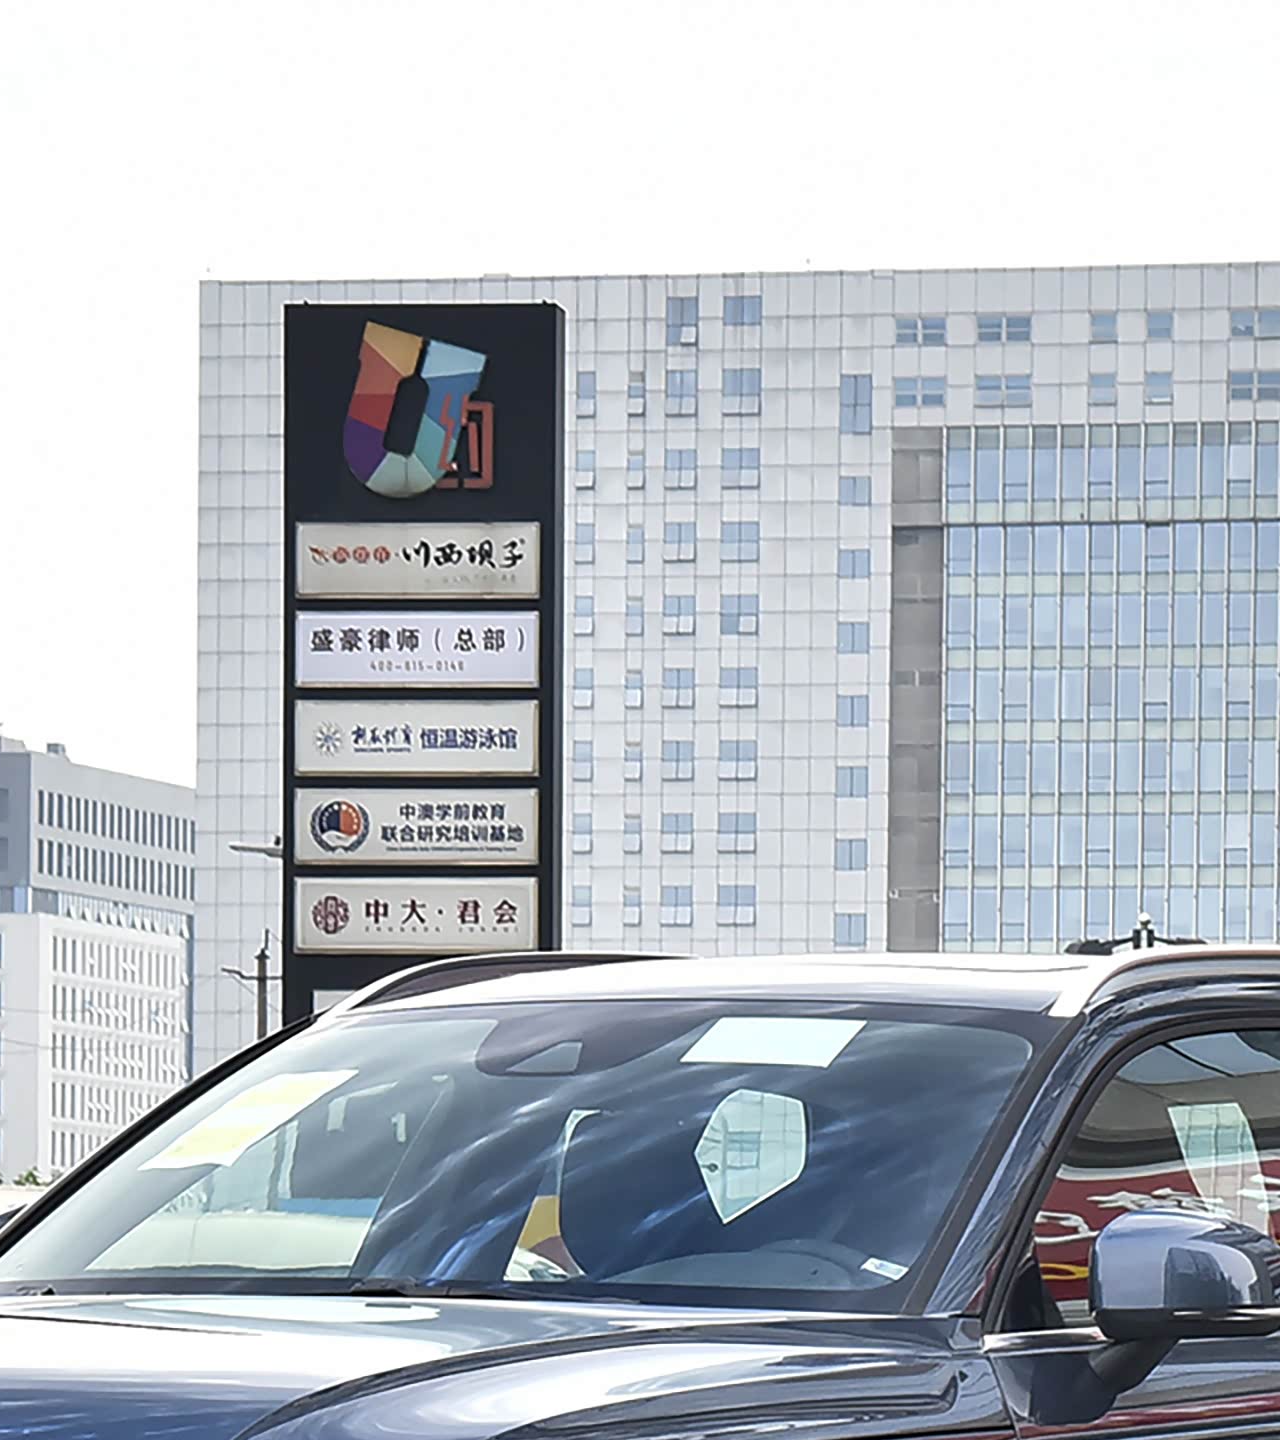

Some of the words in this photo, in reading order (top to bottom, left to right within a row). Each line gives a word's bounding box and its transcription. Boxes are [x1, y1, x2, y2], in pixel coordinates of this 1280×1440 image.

[420, 727, 518, 750] 恒温游泳馆
[399, 803, 506, 820] 中澳学前教育
[381, 824, 524, 842] 联合研究培训基地
[365, 899, 518, 925] 中大·君会
